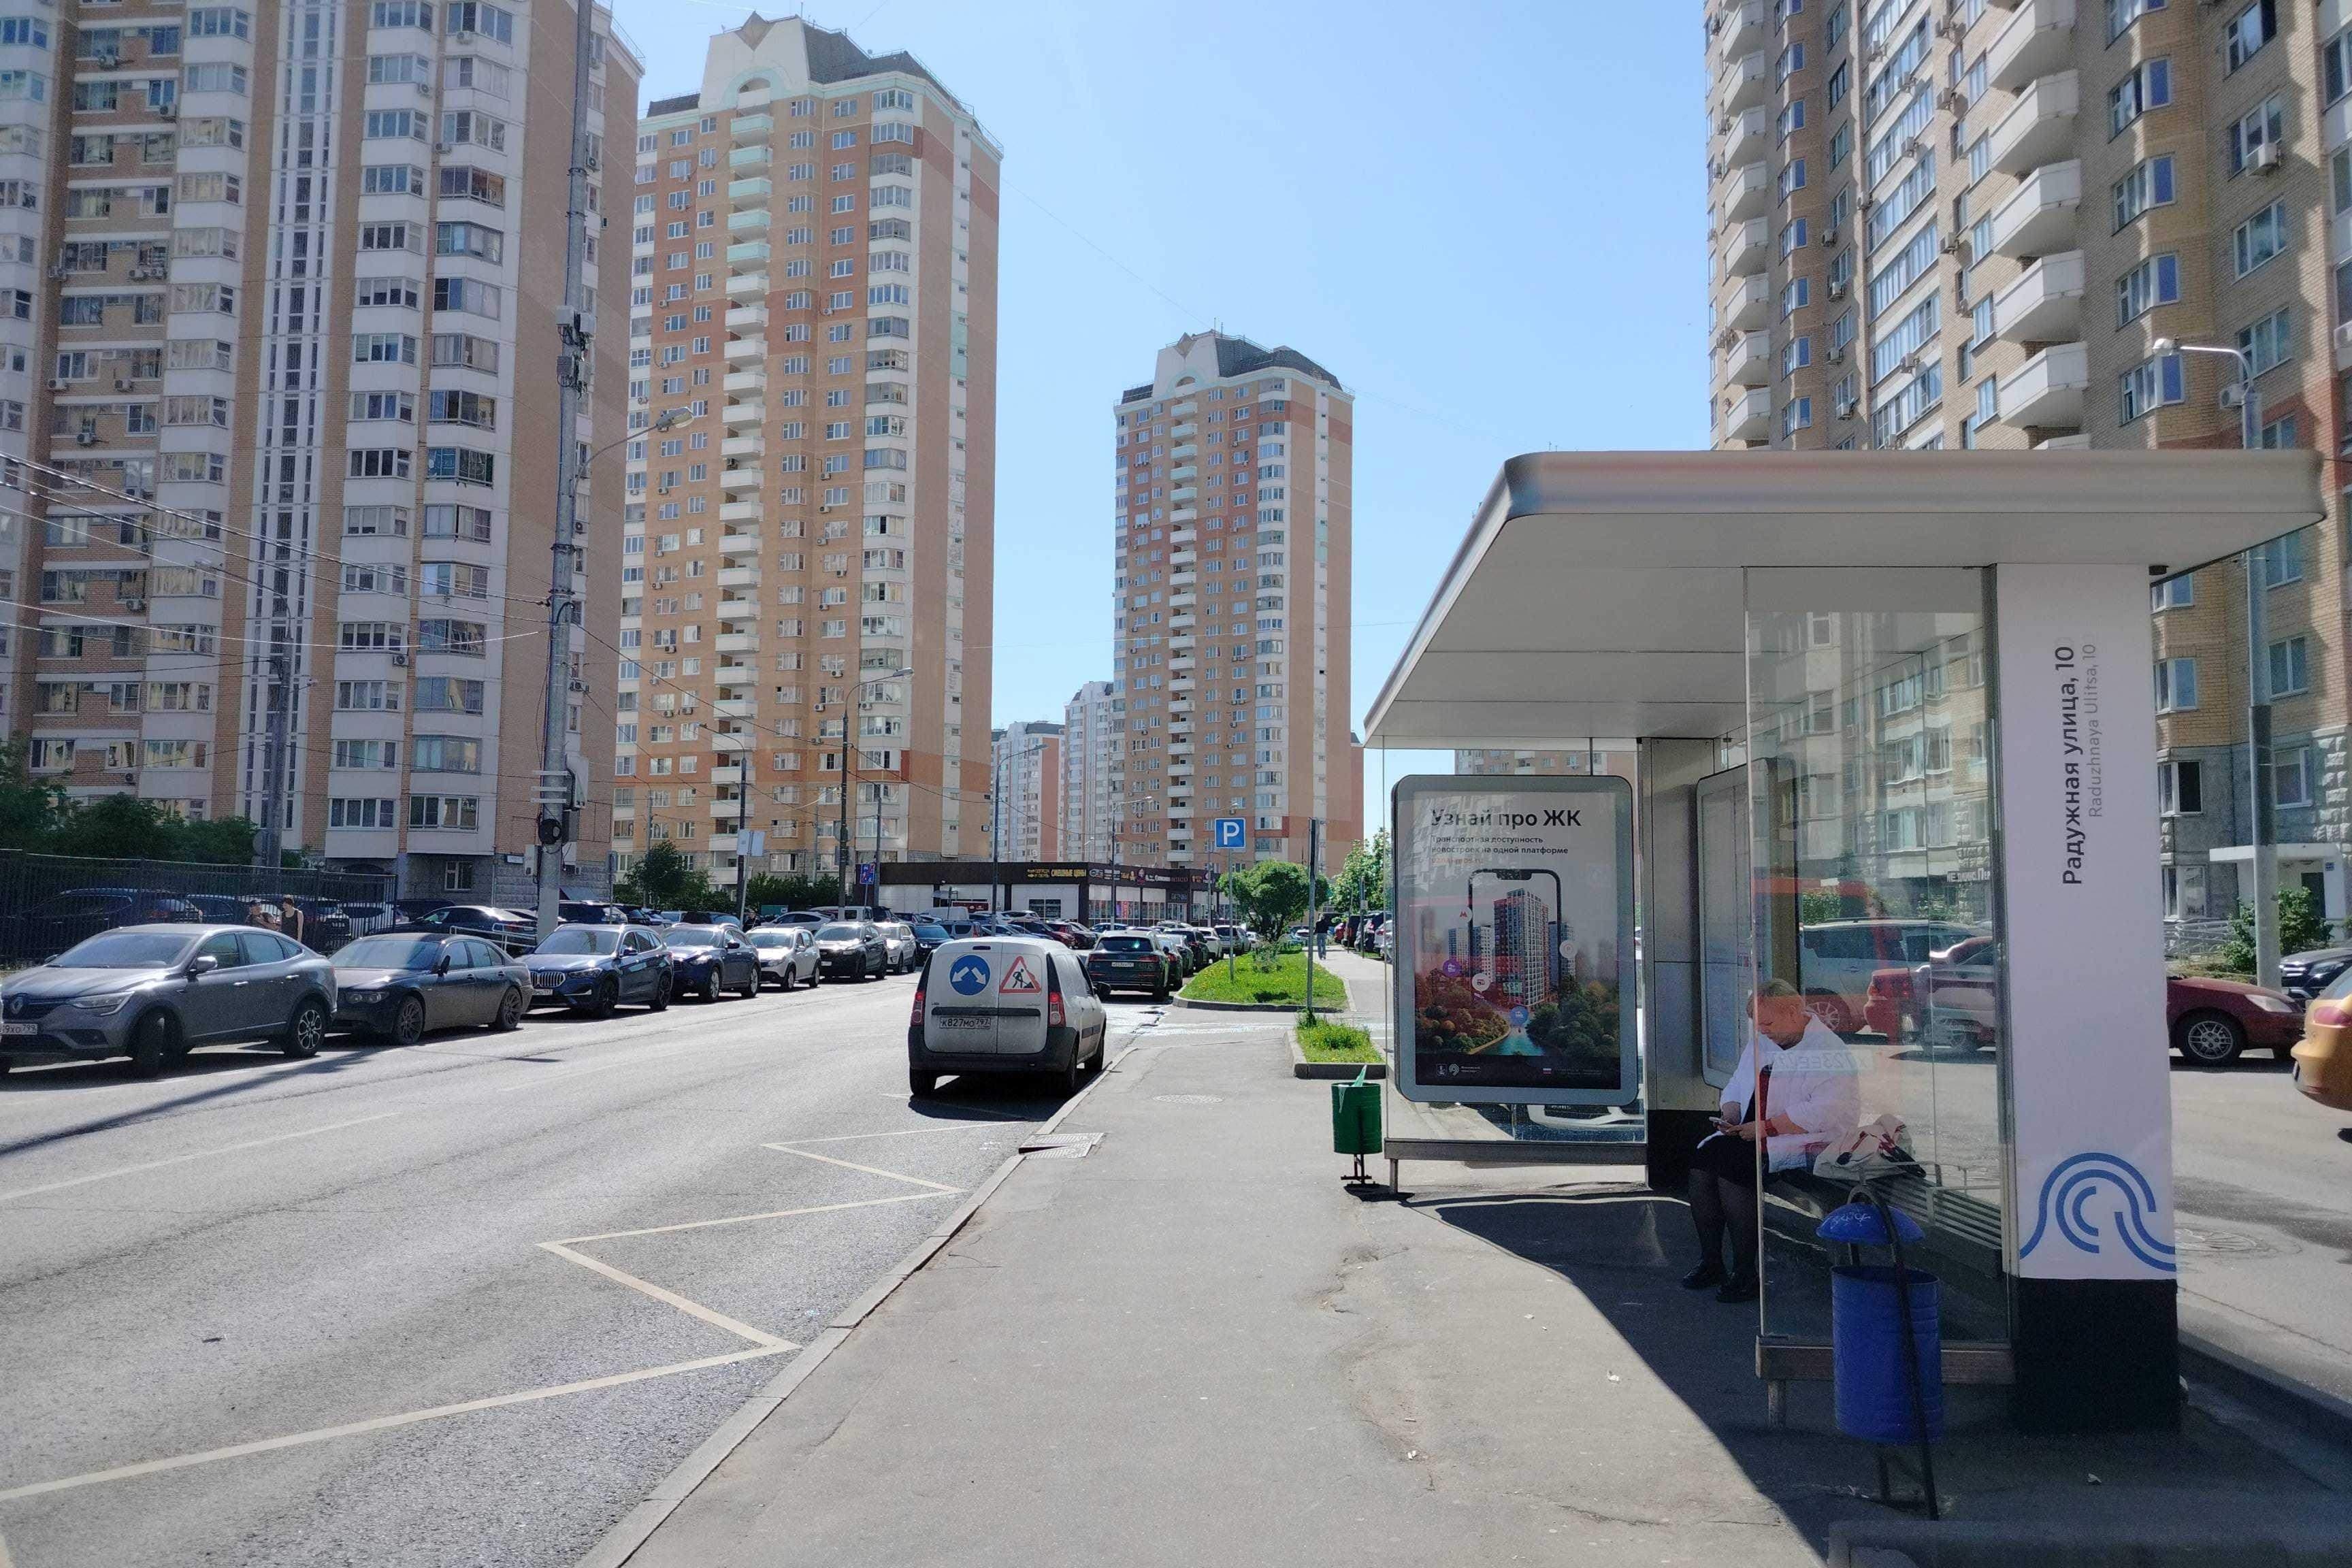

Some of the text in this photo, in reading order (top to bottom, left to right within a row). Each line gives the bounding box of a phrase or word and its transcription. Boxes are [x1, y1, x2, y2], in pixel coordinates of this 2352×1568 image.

[2082, 644, 2102, 817] Raduzhnaya Ulitsa, 10
[2055, 647, 2085, 883] Радужная улица, 10
[1431, 808, 1582, 830] Узнай про ЖК
[1224, 822, 1239, 845] P
[1431, 835, 1544, 845] Транспортная доступность
[1432, 847, 1480, 855] новостроек
[1493, 845, 1519, 855] одной
[1521, 846, 1569, 855] платформе
